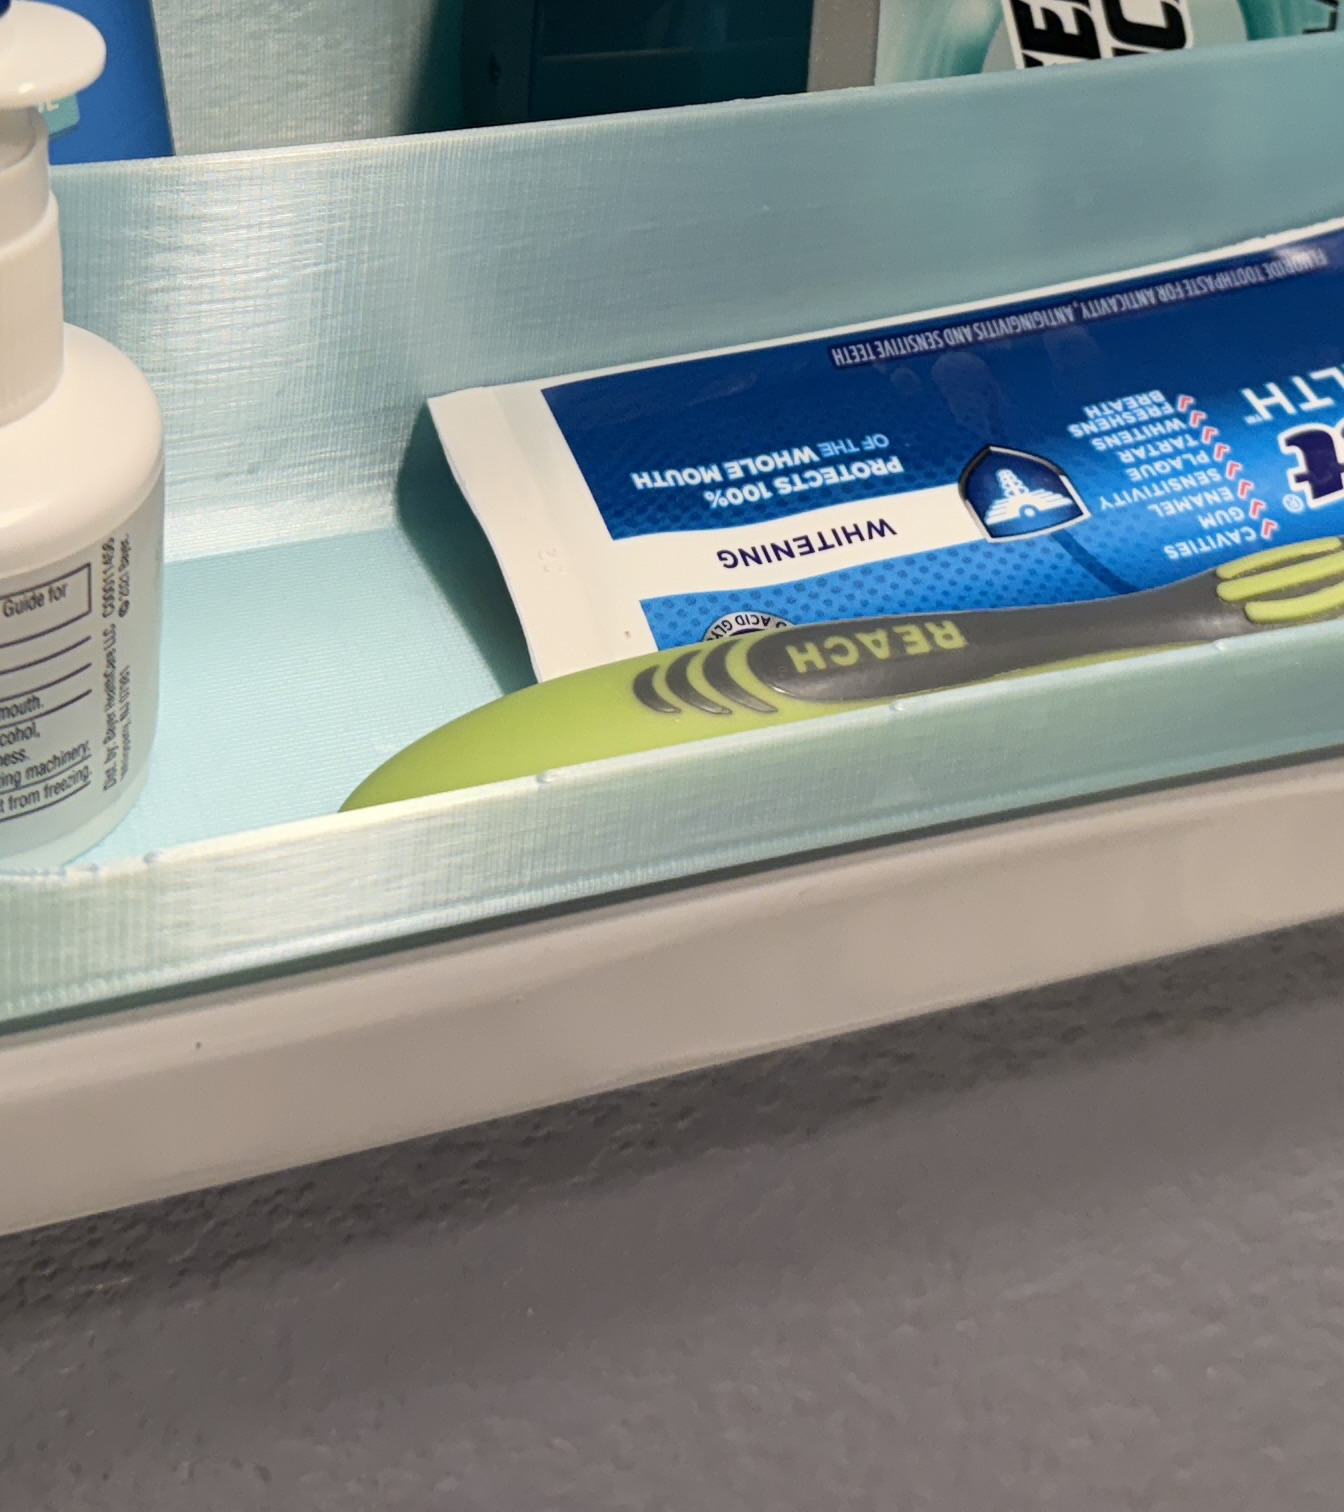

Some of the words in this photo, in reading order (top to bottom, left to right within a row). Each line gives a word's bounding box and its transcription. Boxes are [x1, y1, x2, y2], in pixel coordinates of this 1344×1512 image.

[1156, 280, 1186, 304] FOR
[1186, 261, 1267, 296] TOOTHPASTE
[1074, 287, 1157, 320] ANTICAVITY,
[943, 323, 974, 347] AND
[974, 306, 1075, 341] ANTIGINGIVITIS
[830, 341, 875, 368] TEETH
[876, 329, 943, 359] SENSITIVE
[1067, 401, 1176, 438] FRESHENS
[1083, 389, 1167, 420] BREATH
[818, 437, 861, 459] THE
[861, 433, 890, 452] OF
[1091, 417, 1188, 452] WHITENS
[1117, 433, 1200, 464] TARTAR
[629, 463, 725, 491] MOUTH
[725, 445, 821, 481] WHOLE
[773, 455, 906, 496] PROTECTS
[1125, 449, 1211, 483] PLAQUE
[703, 481, 775, 509] 100%
[1098, 467, 1223, 511] SENSITIVITY
[1147, 485, 1235, 519] ENAMEL
[1197, 505, 1245, 530] GUM
[716, 518, 898, 570] WHITENING
[1163, 525, 1258, 561] CAVITIES
[2, 591, 45, 618] Guide
[48, 583, 69, 603] for
[734, 613, 772, 628] ACID
[785, 619, 969, 674] REACH
[25, 740, 91, 780] machinery.
[8, 788, 41, 813] from
[43, 766, 93, 798] freezing.
